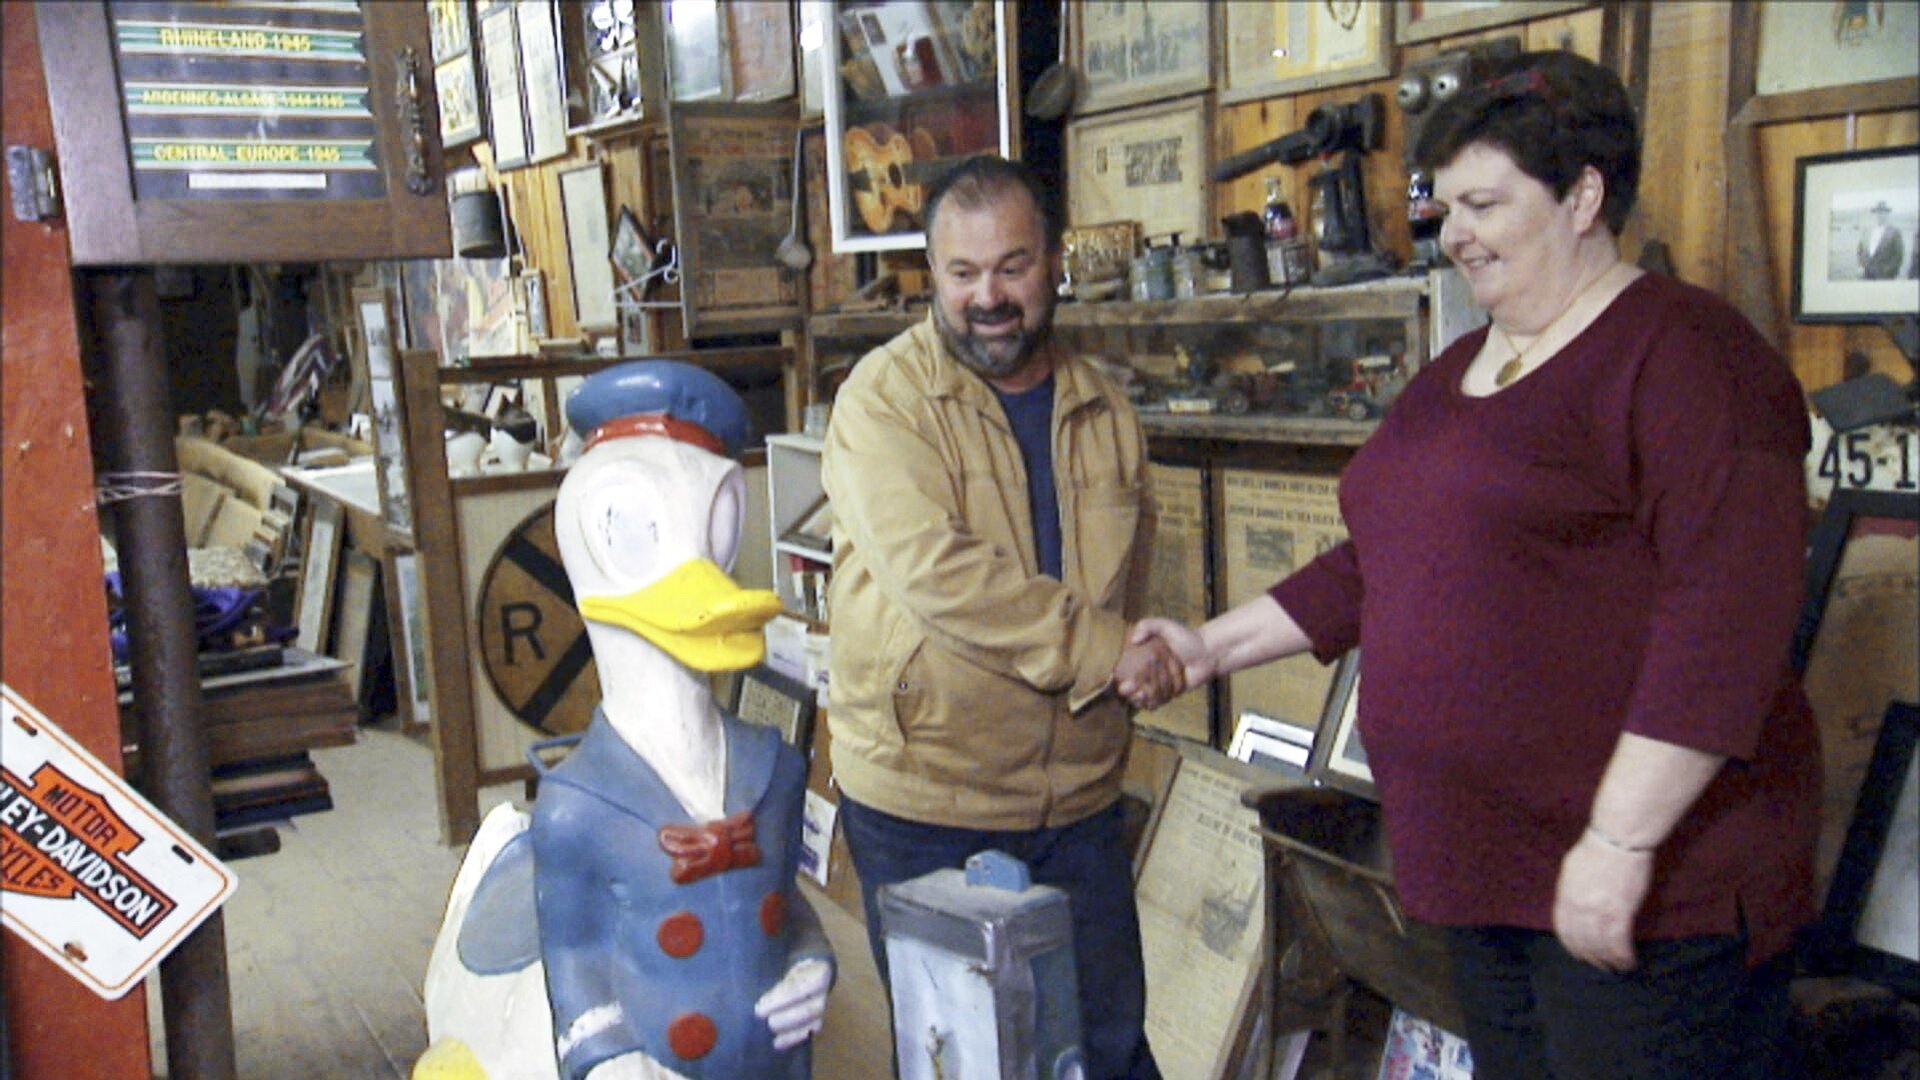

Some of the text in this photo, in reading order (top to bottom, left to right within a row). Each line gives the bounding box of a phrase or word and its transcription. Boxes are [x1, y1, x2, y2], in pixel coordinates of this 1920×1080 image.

[160, 28, 311, 51] RHINELAND 1945
[154, 145, 341, 161] CENTRAL EUROPE 1945
[501, 602, 545, 666] R
[42, 784, 118, 847] MOTOR
[0, 833, 64, 889] YCLES
